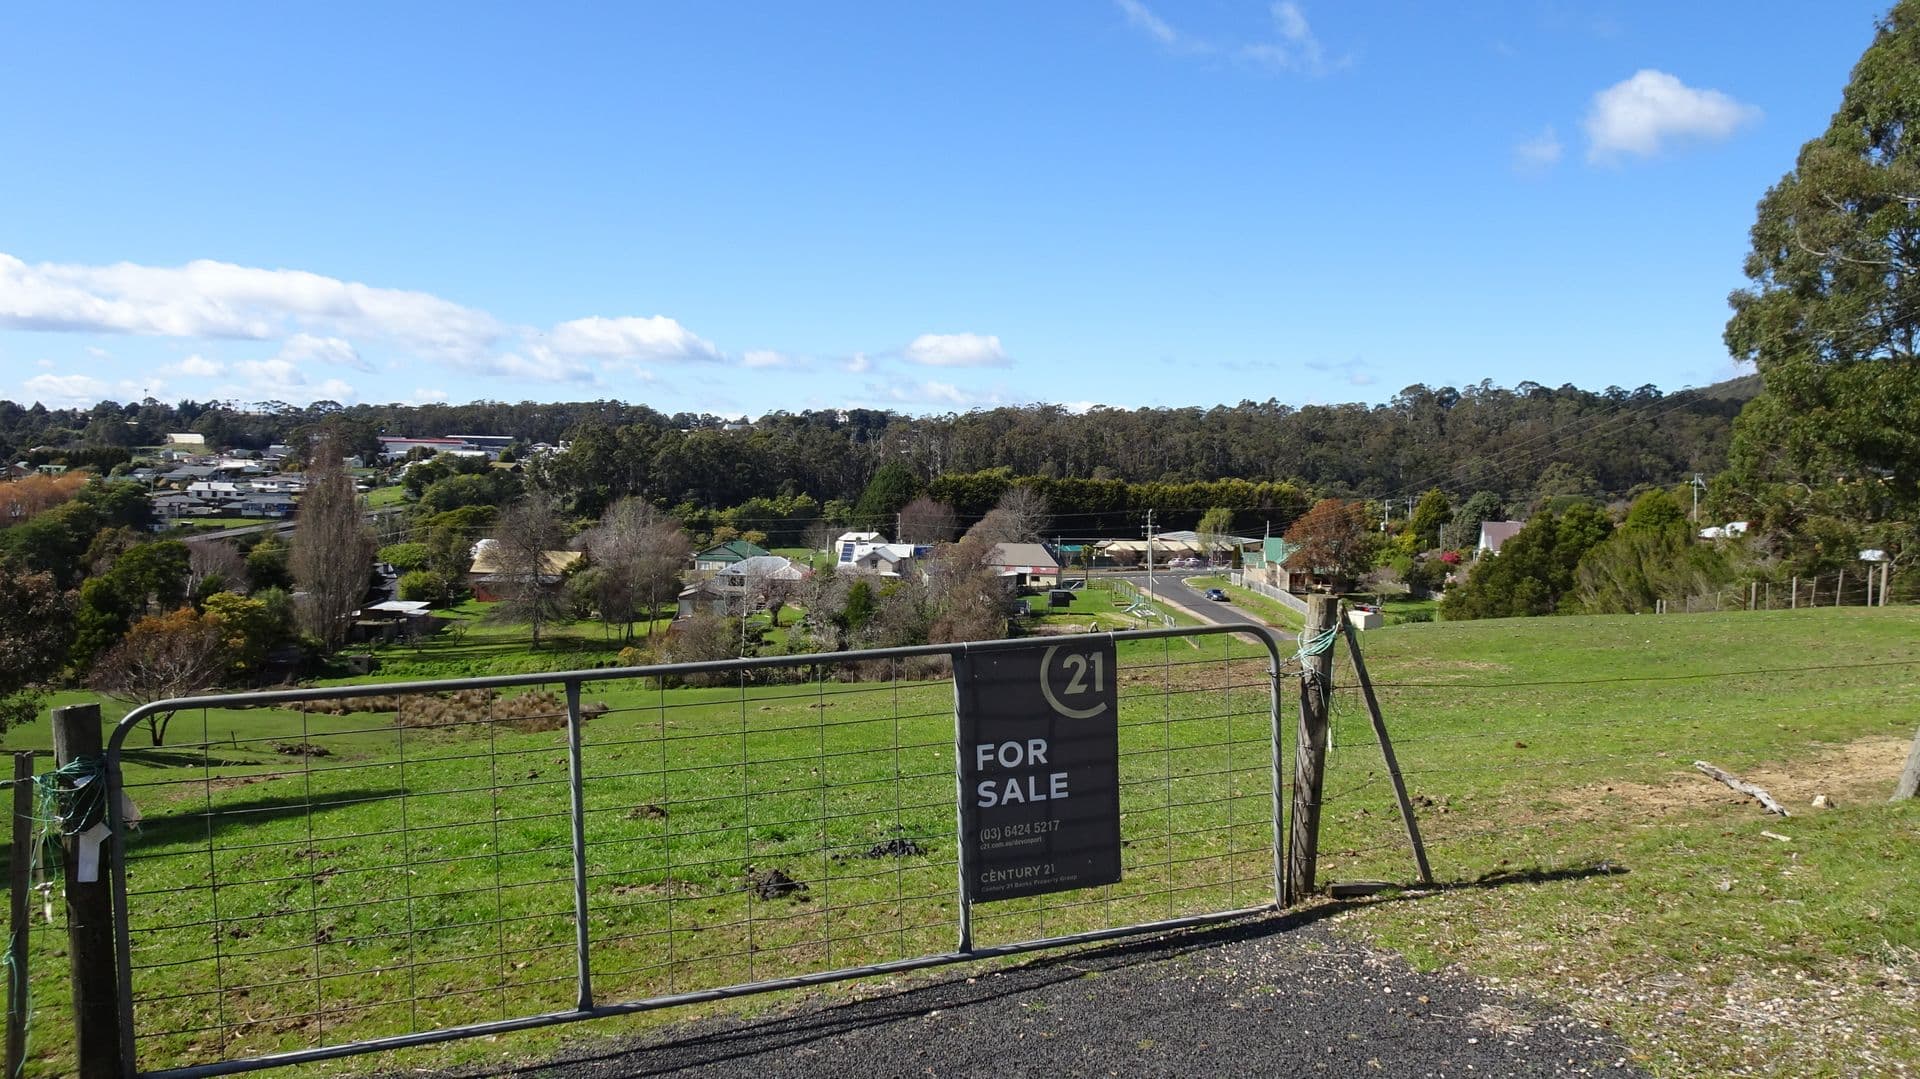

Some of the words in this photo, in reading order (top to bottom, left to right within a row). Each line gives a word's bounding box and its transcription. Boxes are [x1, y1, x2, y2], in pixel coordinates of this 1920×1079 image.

[1062, 651, 1104, 694] 21
[976, 738, 1048, 771] FOR
[977, 772, 1069, 808] SALE
[980, 826, 1001, 843] (03)
[1004, 823, 1031, 837] 6424
[1033, 819, 1060, 833] 5217
[980, 864, 1041, 883] CENTURY
[1043, 863, 1055, 875] 21
